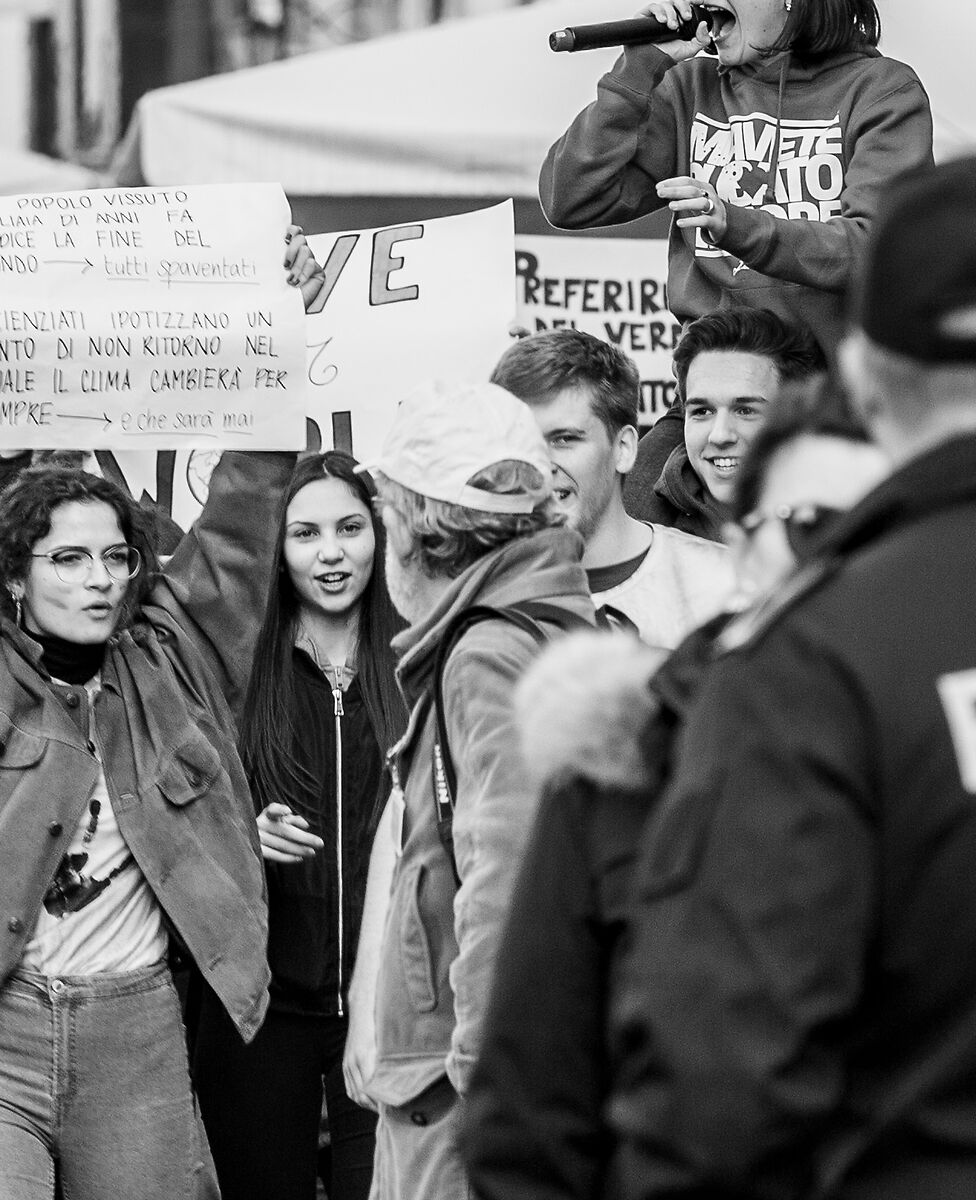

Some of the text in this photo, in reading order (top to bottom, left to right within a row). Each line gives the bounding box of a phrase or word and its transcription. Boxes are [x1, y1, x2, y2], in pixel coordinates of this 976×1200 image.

[17, 190, 188, 210] POPOLO VISSUTO
[60, 213, 80, 227] DI
[96, 211, 140, 225] ANNI
[166, 208, 194, 224] FA
[53, 231, 76, 249] LA
[96, 230, 144, 248] FINE
[174, 228, 212, 248] DEL
[103, 254, 149, 277] tutti
[156, 256, 258, 289] spaventati
[0, 310, 273, 332] IENZIATI IPOTIZZANO UN
[57, 337, 73, 360] DI
[88, 335, 131, 357] NON
[142, 335, 222, 357] RITORNO
[244, 335, 279, 358] NEL
[0, 366, 288, 394] ALE IL CLIMA CAMBIERÀ PER
[136, 408, 167, 431] che
[173, 409, 215, 430] sarà
[222, 410, 254, 429] mai
